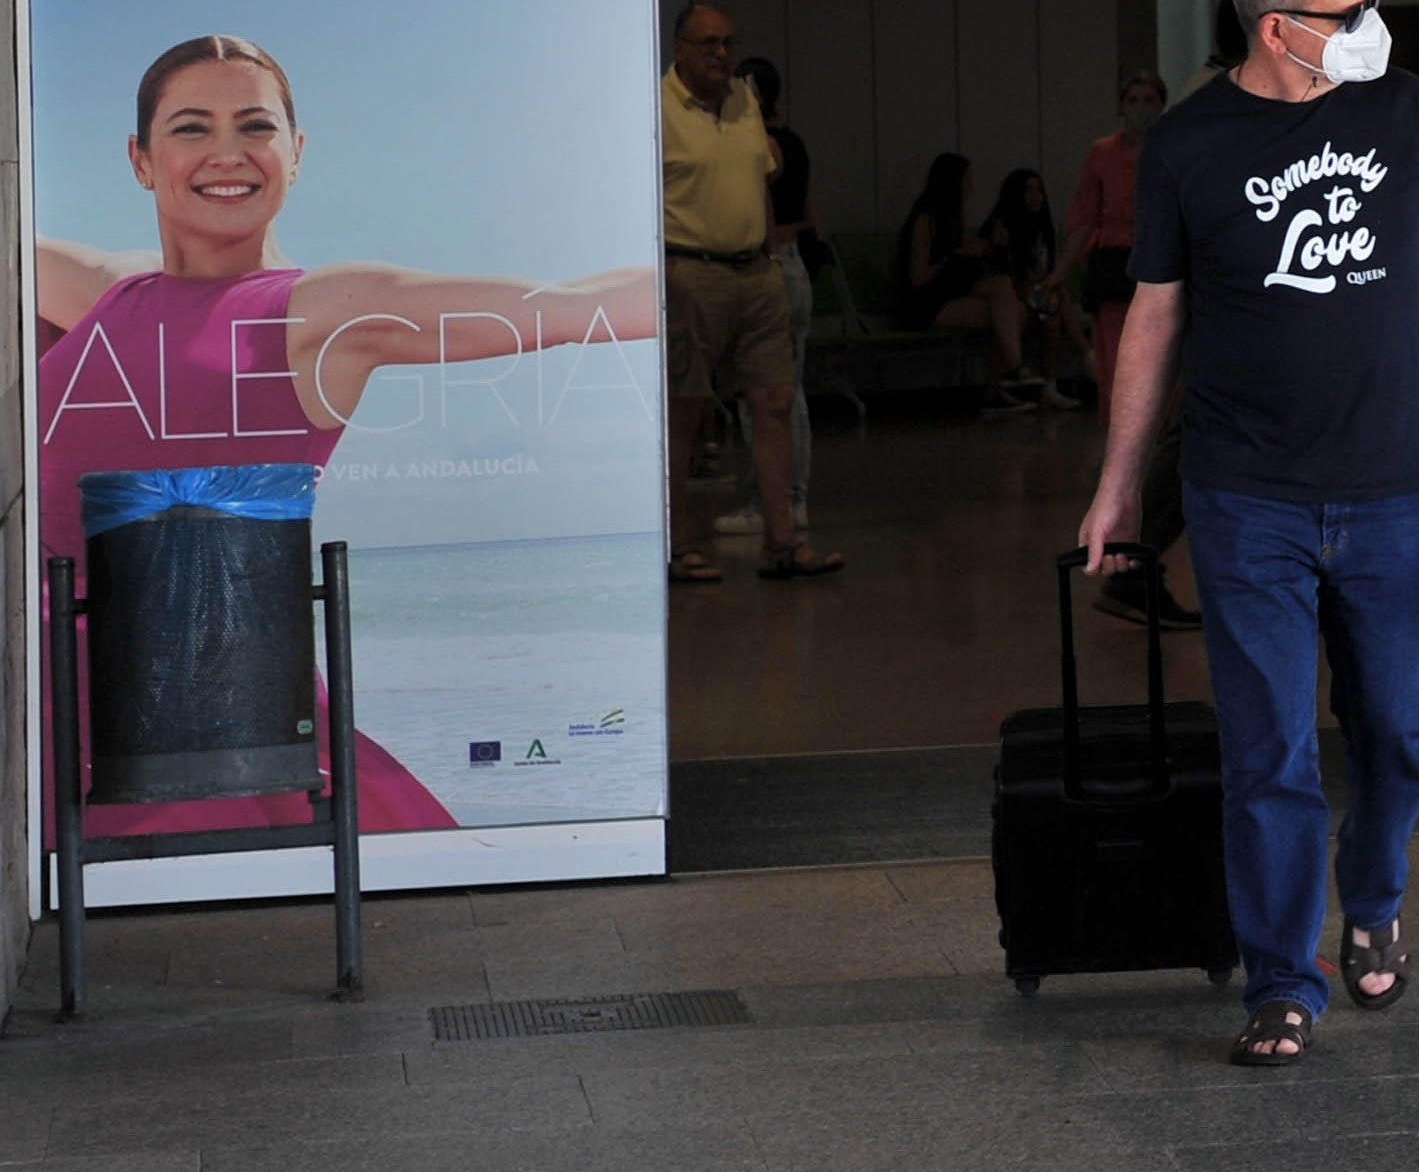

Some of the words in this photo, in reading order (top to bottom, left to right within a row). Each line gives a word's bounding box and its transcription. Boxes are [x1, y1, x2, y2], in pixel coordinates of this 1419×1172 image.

[1244, 140, 1388, 222] Somebody
[1323, 185, 1362, 224] to
[1263, 208, 1376, 294] Love
[1346, 266, 1387, 285] QUEEN
[43, 282, 656, 445] ALEGRÍA
[333, 462, 378, 481] VEN
[383, 462, 402, 479] A
[402, 452, 541, 480] ANDALUCÍA
